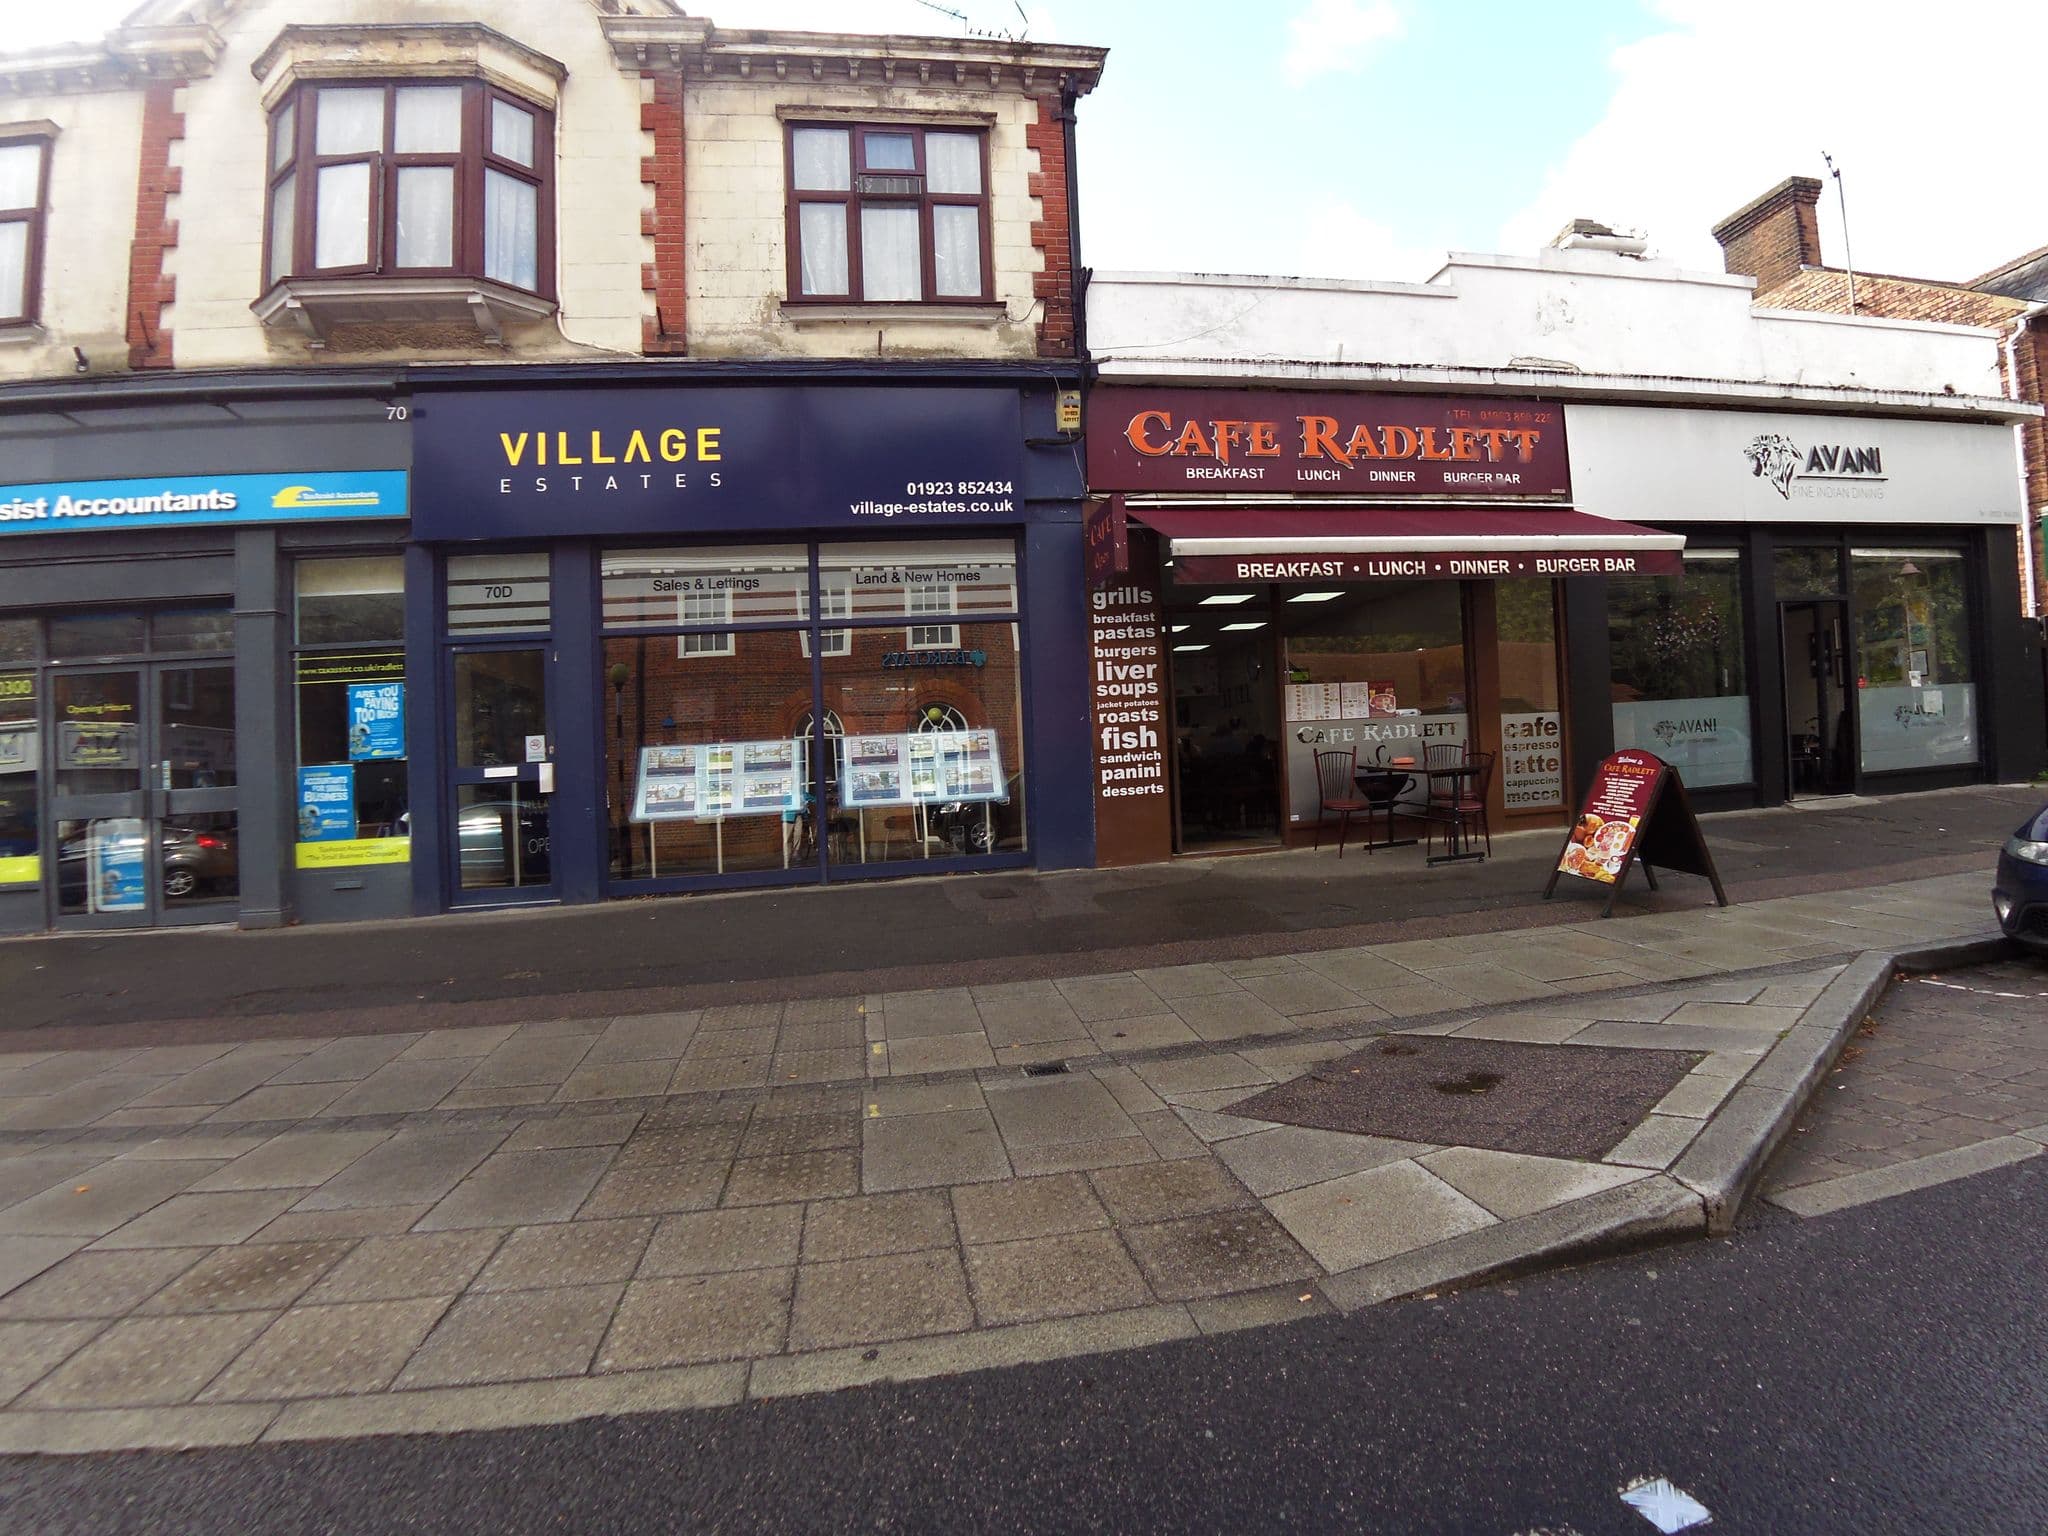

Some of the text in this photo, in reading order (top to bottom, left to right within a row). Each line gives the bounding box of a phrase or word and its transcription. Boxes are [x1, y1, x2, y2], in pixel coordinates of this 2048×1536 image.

[386, 406, 407, 420] 70
[500, 428, 721, 466] VILLAGE
[1124, 410, 1540, 469] CAFE RADLETT
[1805, 444, 1882, 473] AVANI
[1186, 468, 1265, 479] BREAKFAST
[1297, 470, 1340, 481] LUNCH
[1369, 471, 1416, 482] DINNER
[1443, 472, 1492, 483] BURGER
[500, 472, 721, 493] ESTATES
[906, 481, 1013, 496] 01923 852434
[1792, 485, 1815, 498] FINE
[52, 489, 237, 518] Accountants
[850, 499, 1014, 517] village-estates.co.uk
[1236, 561, 1344, 578] BREAKFAST
[1368, 561, 1426, 576] LUNCH
[1449, 560, 1511, 574] DINNER
[1535, 558, 1636, 573] BURGER BAR
[653, 577, 760, 592] Sales & Lettings
[856, 570, 981, 585] Land & New Homes
[485, 585, 512, 599] 70D
[1092, 586, 1153, 610] grills
[1093, 612, 1155, 624] breakfast
[1093, 626, 1156, 643] pastas
[1094, 646, 1157, 660] burgers
[1096, 661, 1157, 681] liver
[354, 685, 399, 699] ARE YOU
[1096, 682, 1159, 698] soups
[364, 697, 399, 711] PAYING
[1096, 700, 1159, 710] jacket potatoes
[354, 707, 375, 724] TOO
[1098, 708, 1159, 724] roasts
[1297, 722, 1457, 744] CAFE RADLETT
[1503, 716, 1558, 738] cafe
[1679, 718, 1716, 733] AVANI
[1101, 725, 1157, 750] fish
[1503, 741, 1559, 752] espresso
[1100, 750, 1162, 764] sandwich
[1504, 754, 1559, 774] latte
[1101, 762, 1161, 784] panini
[1102, 783, 1164, 797] desserts
[1506, 777, 1559, 788] cappuccino
[1506, 789, 1560, 802] mocca
